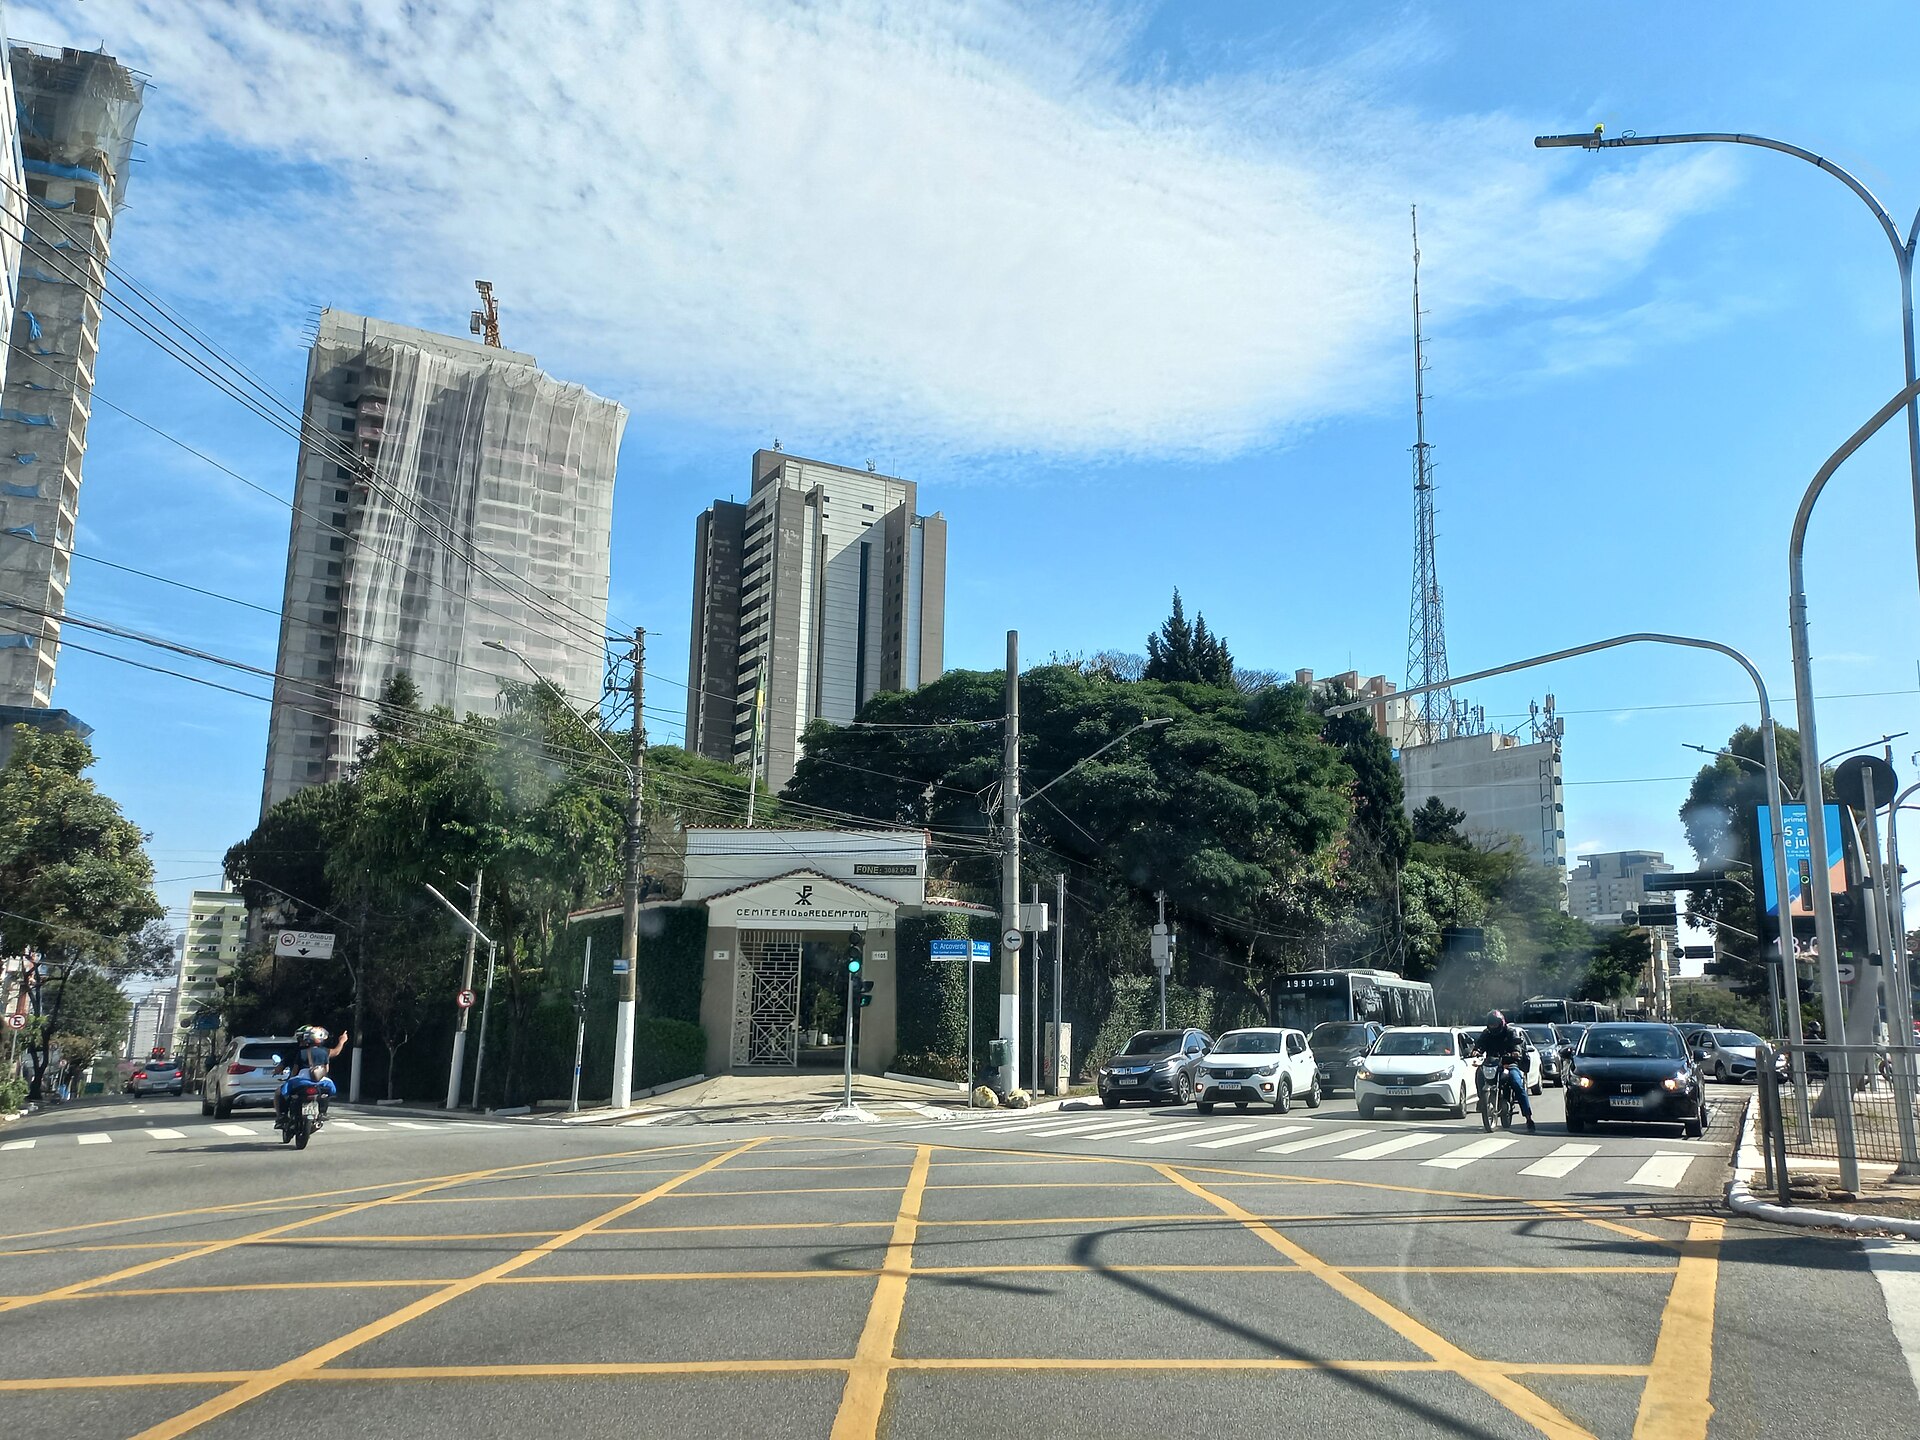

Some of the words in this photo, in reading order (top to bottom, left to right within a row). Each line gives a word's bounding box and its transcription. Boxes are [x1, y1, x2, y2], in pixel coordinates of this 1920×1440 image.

[1795, 836, 1810, 849] jul
[736, 908, 797, 917] CEMITERIO
[808, 909, 869, 918] REDEMPTOR
[939, 942, 967, 950] Arcoverde
[1286, 978, 1335, 988] 1990-10
